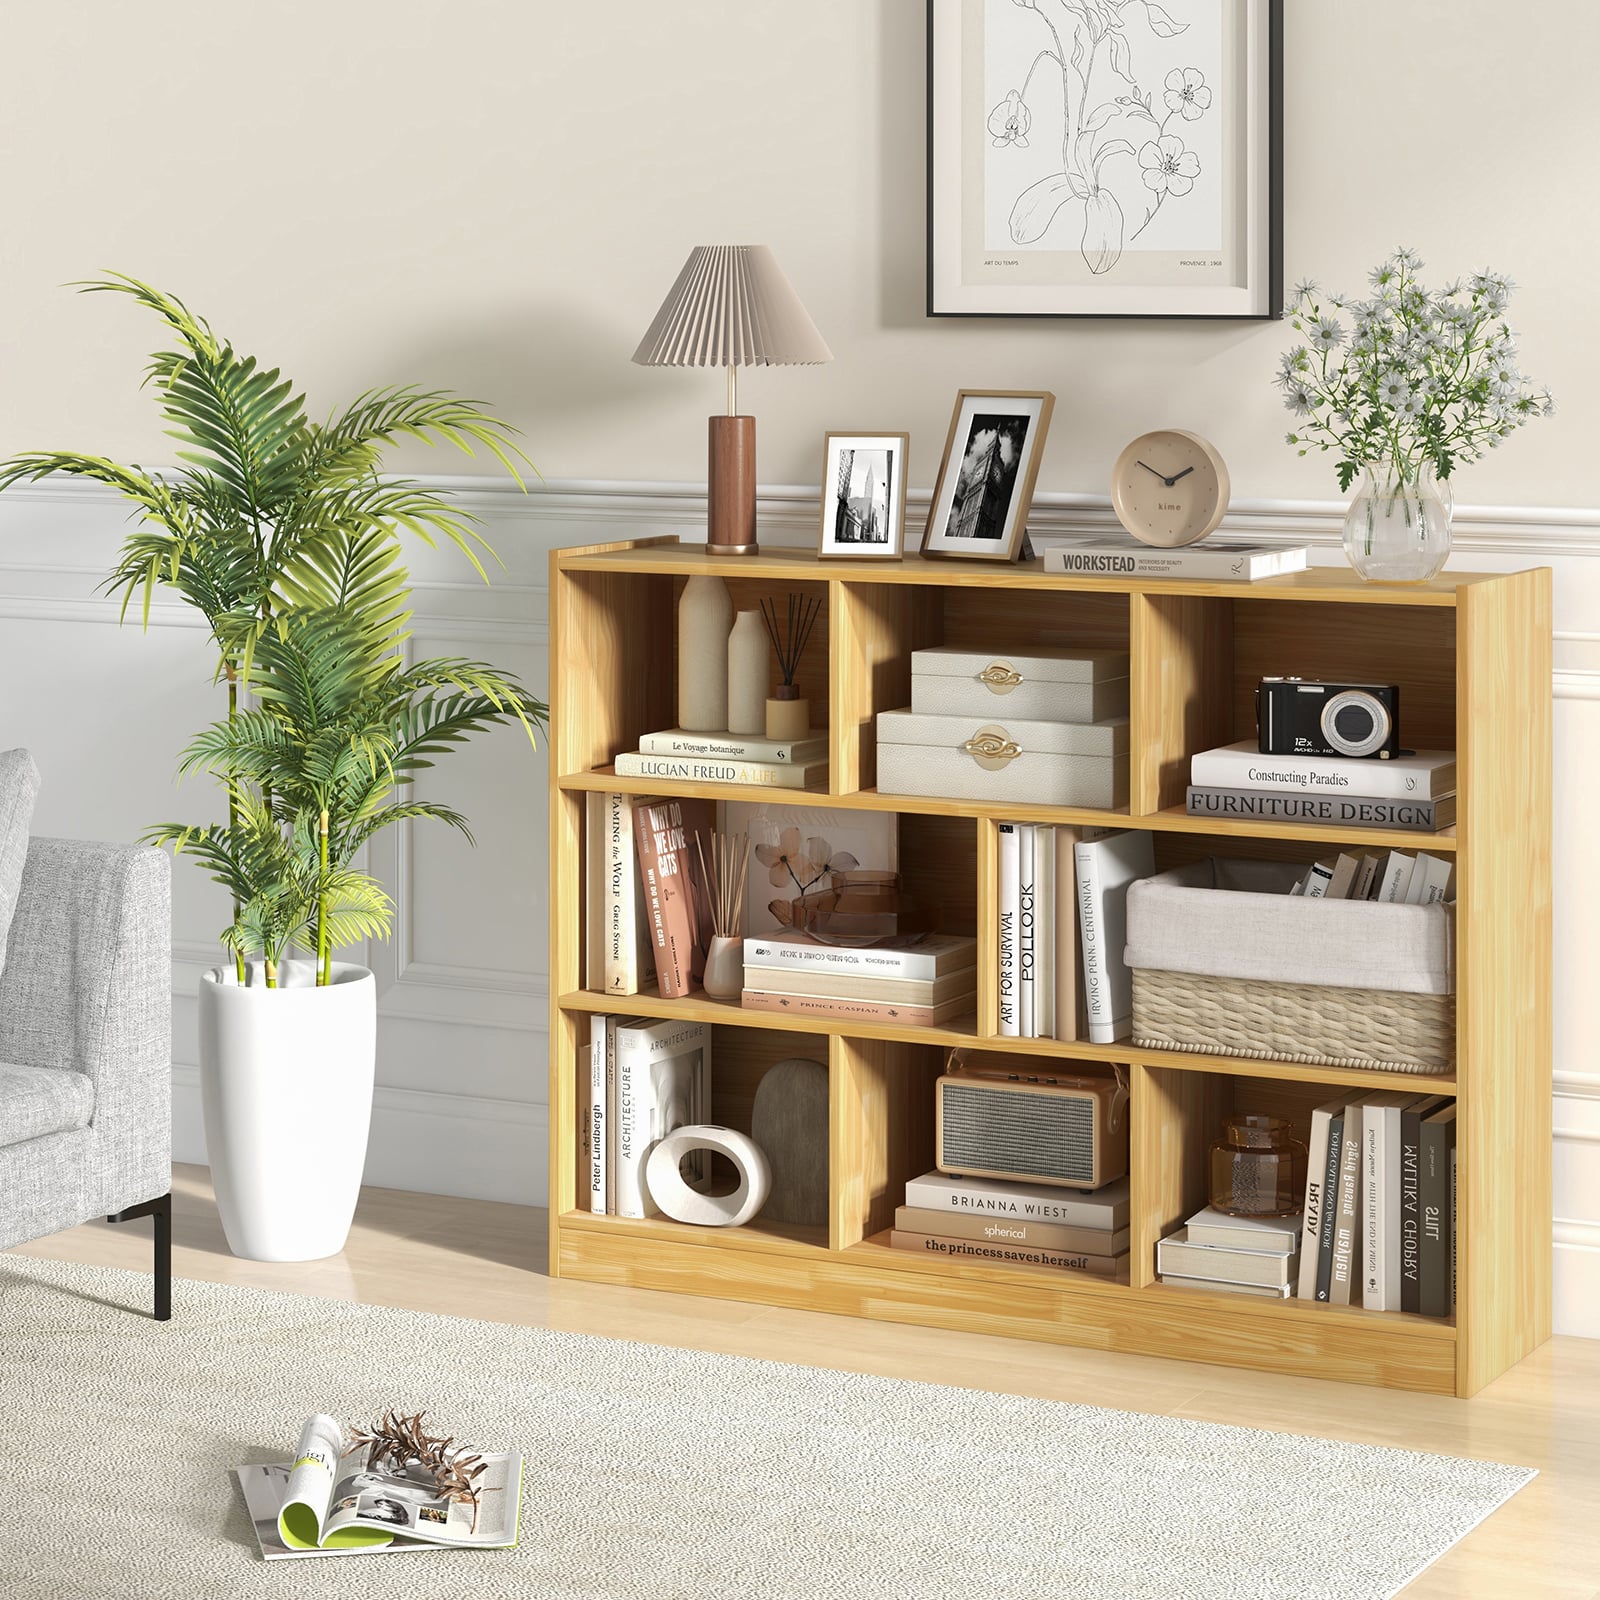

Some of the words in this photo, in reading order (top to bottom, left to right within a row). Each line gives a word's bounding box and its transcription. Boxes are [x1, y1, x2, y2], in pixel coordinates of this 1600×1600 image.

[1063, 554, 1136, 572] WORKSTEAD
[673, 742, 681, 750] Le
[682, 743, 708, 753] Voyage
[709, 744, 745, 756] botanique
[1295, 737, 1313, 746] 12x
[641, 762, 689, 776] LUCIAN
[694, 766, 736, 780] FREUD
[739, 769, 748, 780] A
[752, 770, 777, 783] LIFE
[1248, 768, 1307, 786] Constructing
[1310, 771, 1349, 786] Paradies
[612, 793, 622, 843] TAMING
[648, 805, 669, 832] WHY
[669, 802, 682, 827] DO
[1191, 793, 1332, 819] FURNITURE
[1341, 802, 1433, 825] DESIGN
[653, 831, 669, 855] WE
[667, 827, 687, 852] LOVE
[647, 868, 655, 884] WHY
[657, 852, 678, 878] CATS
[612, 861, 623, 898] WOLF
[650, 886, 657, 896] DO
[652, 897, 658, 908] WE
[1082, 879, 1096, 941] CENTENNIAL
[653, 909, 662, 928] LOVE
[657, 929, 666, 948] CATS
[1001, 912, 1013, 968] SURVIVAL
[1022, 883, 1034, 982] POLLOCK
[1089, 944, 1099, 974] PENN:
[1001, 972, 1012, 997] FOR
[1092, 977, 1101, 1015] IRVING
[800, 1002, 835, 1010] PRINCE
[838, 1005, 879, 1014] CASPIAN
[1001, 1001, 1012, 1025] ART
[650, 1026, 704, 1052] ARCHITECTURE
[622, 1066, 631, 1159] ARCHITECTURE
[592, 1104, 603, 1160] Lindbergh
[592, 1161, 601, 1192] Peter
[951, 1195, 1017, 1213] BRIANNA
[1025, 1204, 1068, 1218] WIEST
[984, 1224, 1026, 1240] spherical
